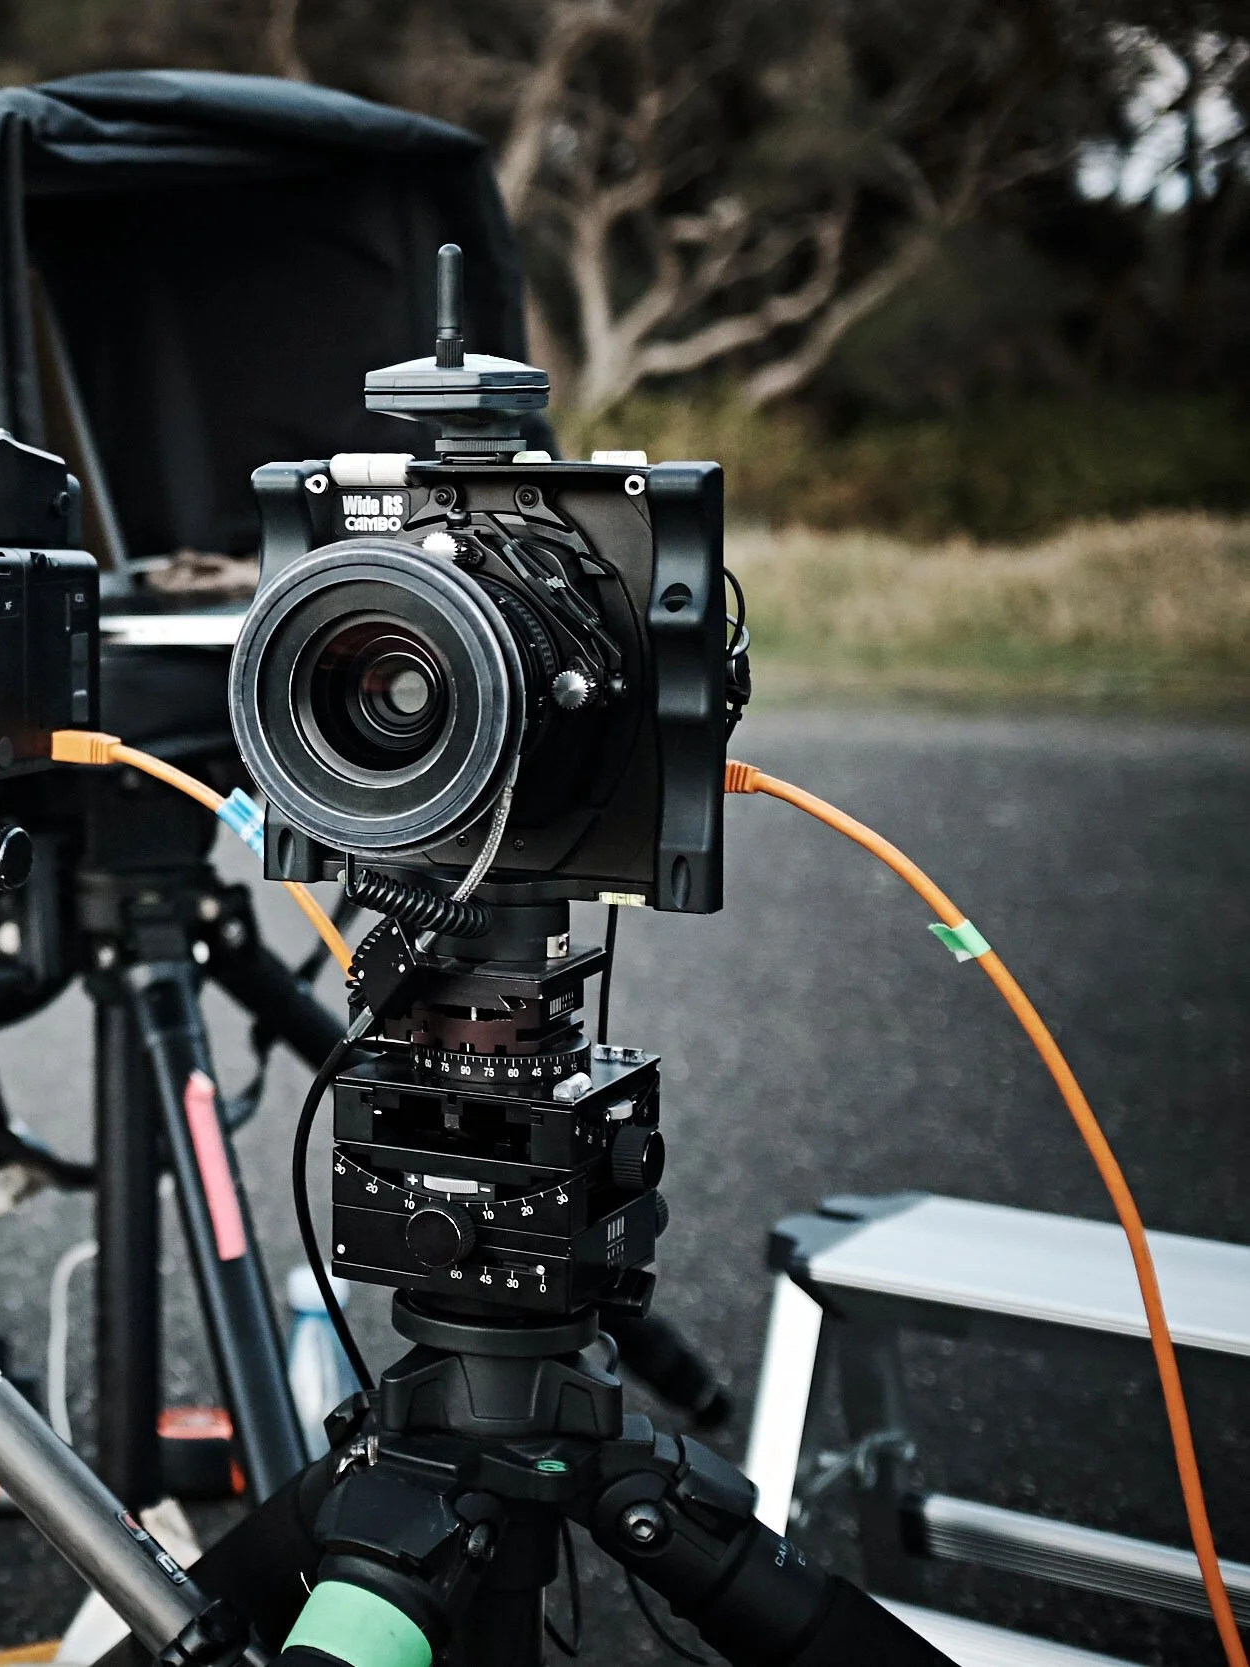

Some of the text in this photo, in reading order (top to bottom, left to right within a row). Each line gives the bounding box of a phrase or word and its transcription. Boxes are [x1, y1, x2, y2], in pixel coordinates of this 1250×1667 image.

[342, 495, 404, 515] Wide RS
[344, 516, 402, 531] CAMBO
[440, 1061, 450, 1073] 75
[460, 1065, 471, 1076] 90
[483, 1067, 495, 1078] 75
[507, 1068, 519, 1078] 60
[531, 1068, 542, 1077] 45
[553, 1066, 562, 1075] 30
[334, 1163, 569, 1220] 30 20 10 10 20 30
[450, 1269, 547, 1293] 60 45 30 0
